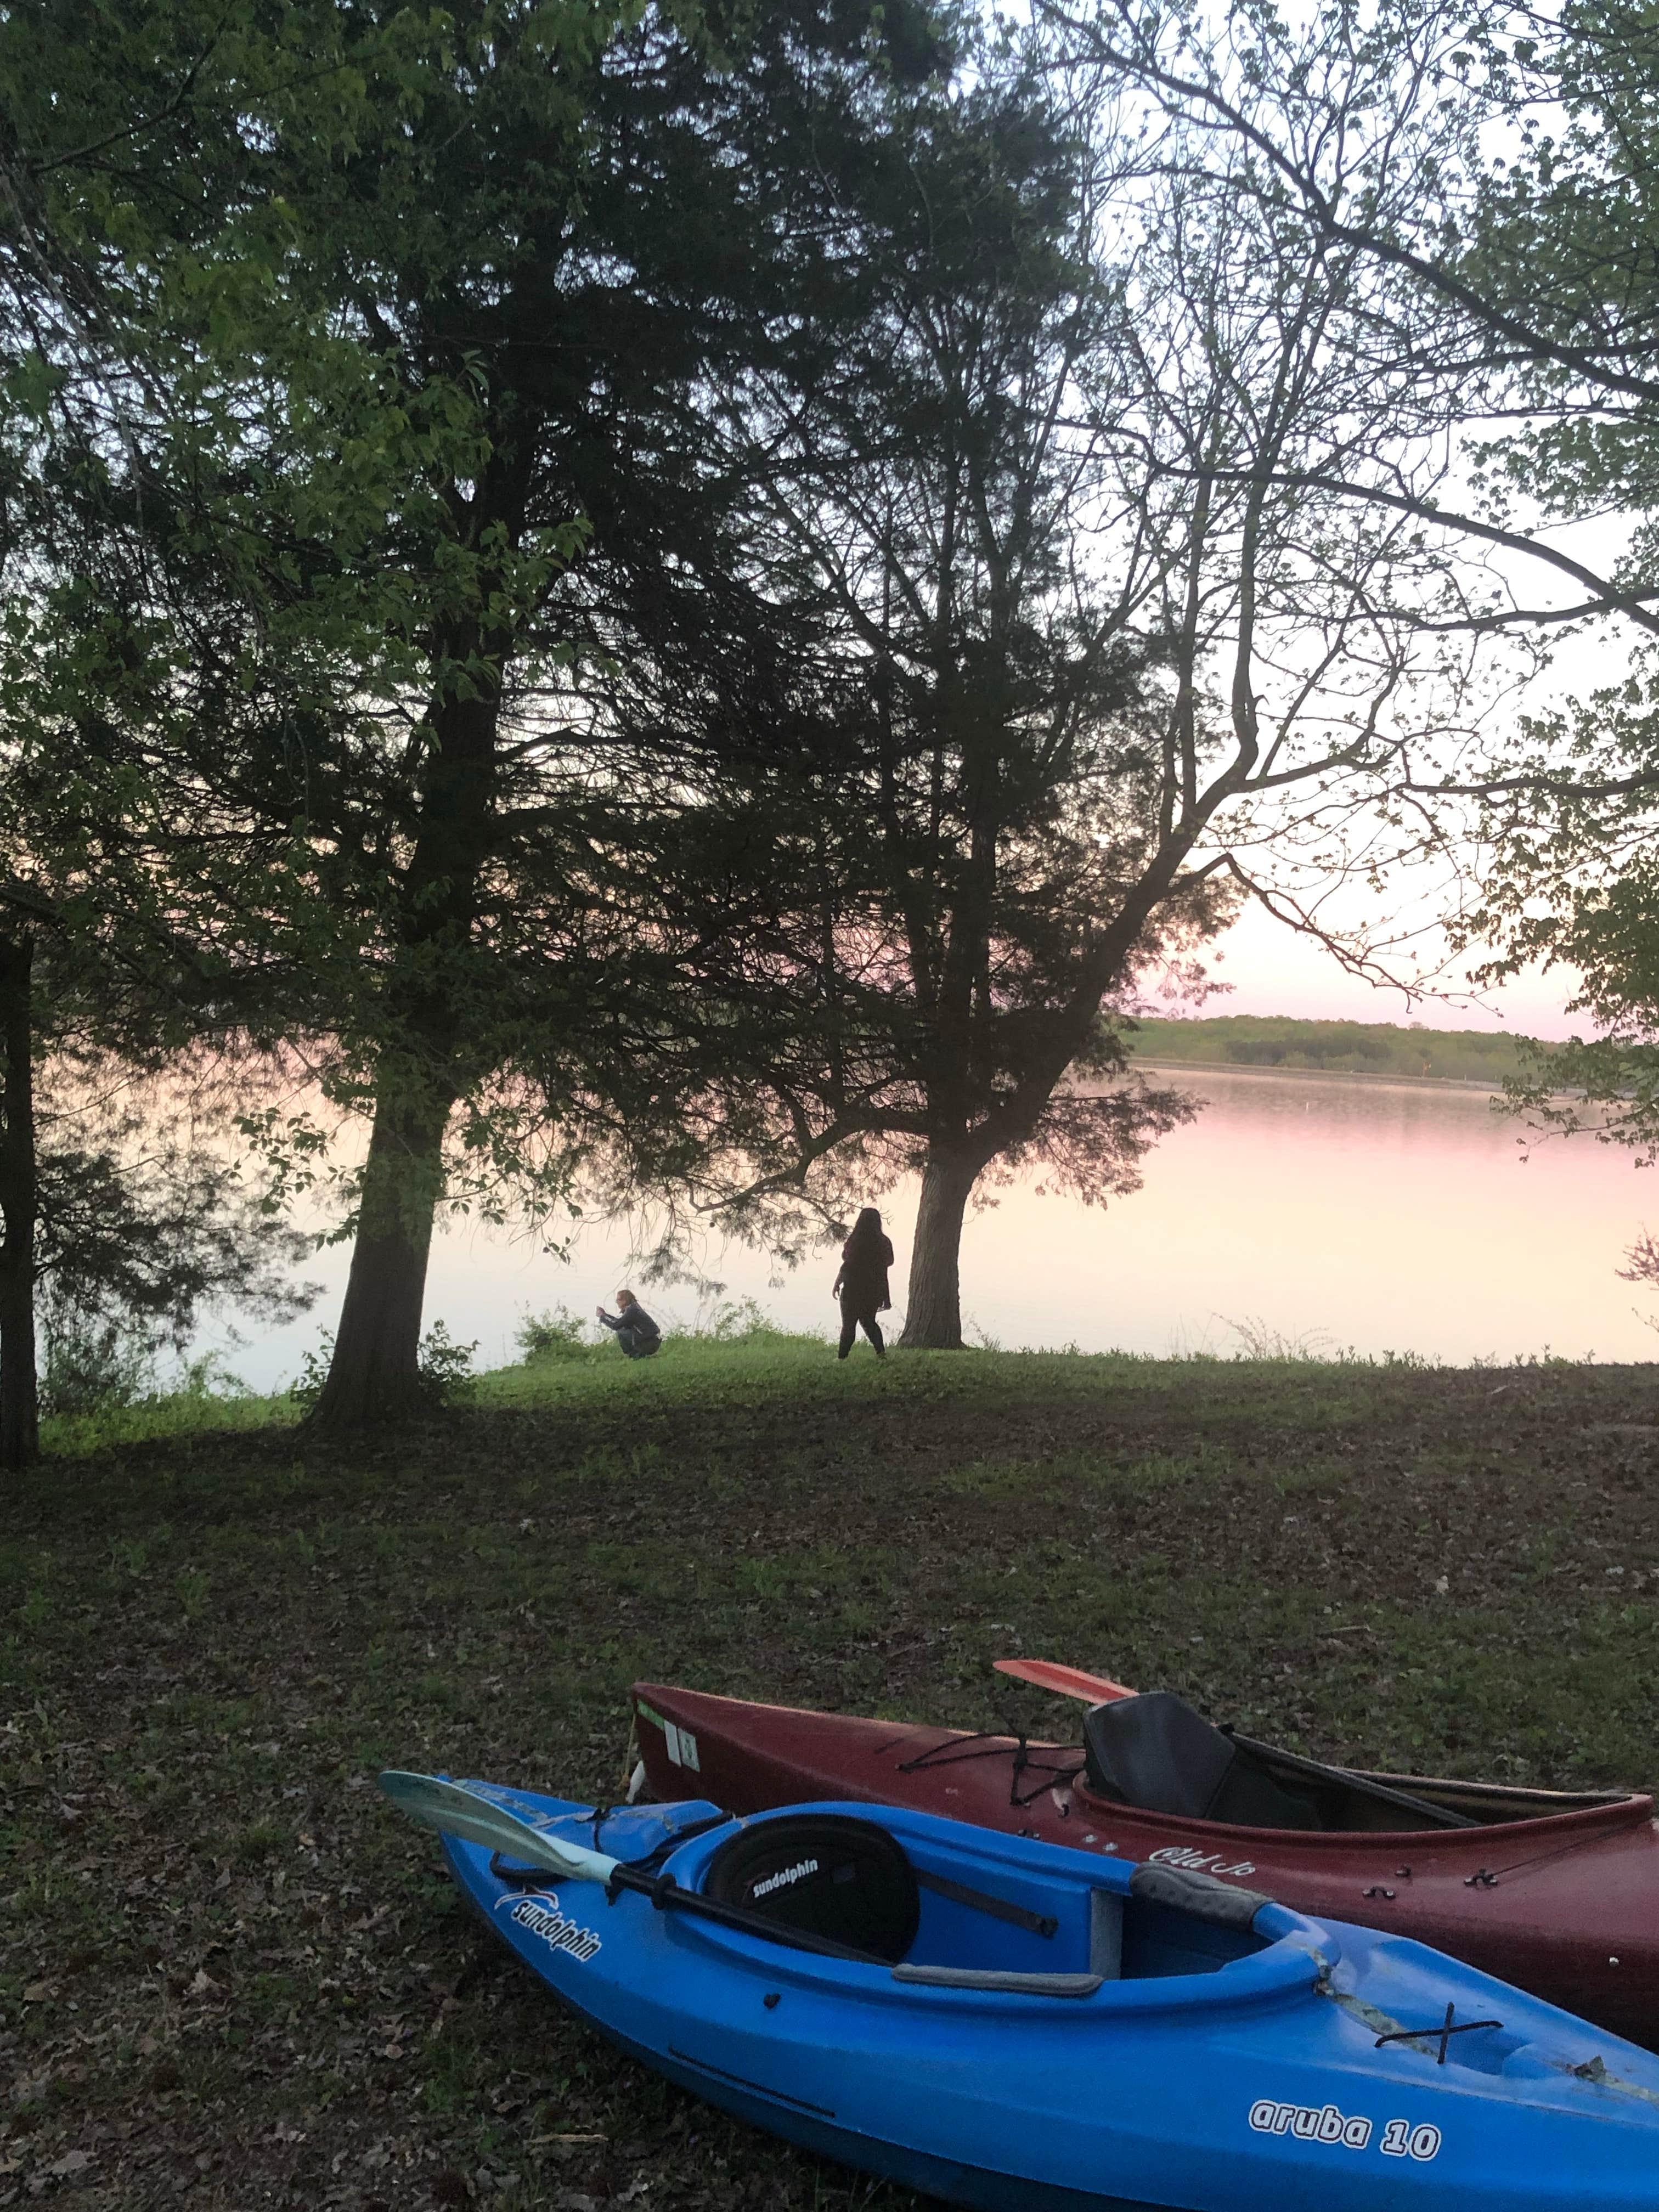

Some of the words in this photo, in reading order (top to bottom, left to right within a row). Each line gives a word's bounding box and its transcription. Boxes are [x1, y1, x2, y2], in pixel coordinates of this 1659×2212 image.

[753, 1859, 819, 1898] sundolphin
[1149, 1847, 1222, 1868] Old
[511, 1900, 602, 1962] sundolphin
[1250, 2101, 1372, 2148] aruba
[1381, 2120, 1440, 2160] 10
